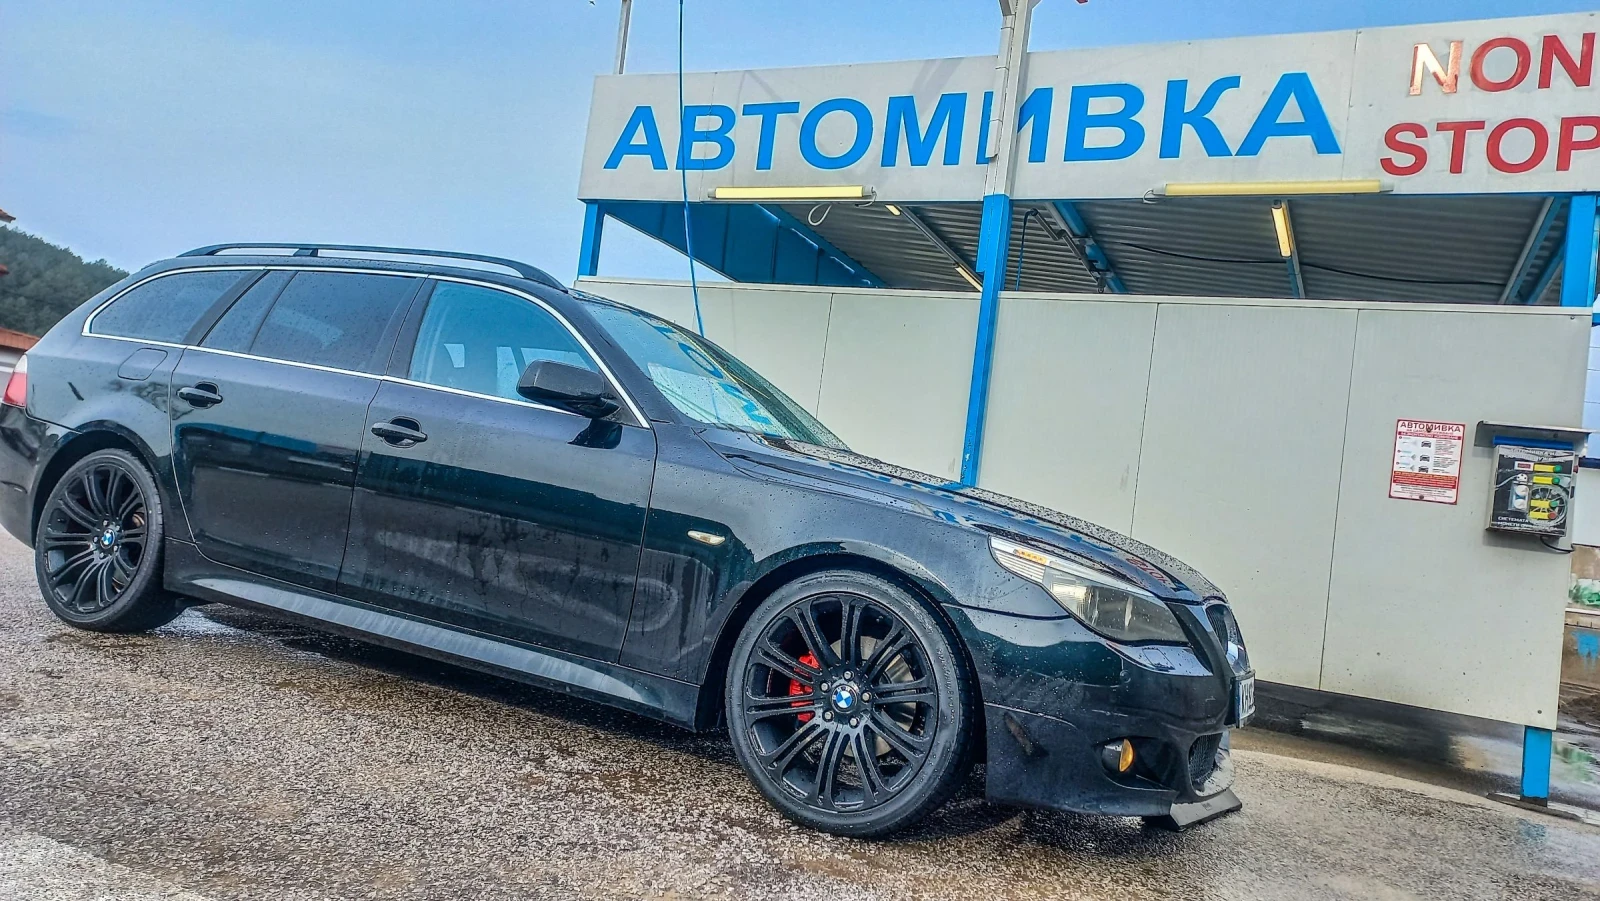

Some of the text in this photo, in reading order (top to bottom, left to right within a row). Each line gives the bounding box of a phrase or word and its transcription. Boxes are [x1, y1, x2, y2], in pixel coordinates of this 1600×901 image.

[1409, 32, 1596, 96] NON
[603, 72, 1342, 171] АВТОМИВКА
[1380, 115, 1600, 177] STOP
[1400, 421, 1461, 433] АВТОМИВКА
